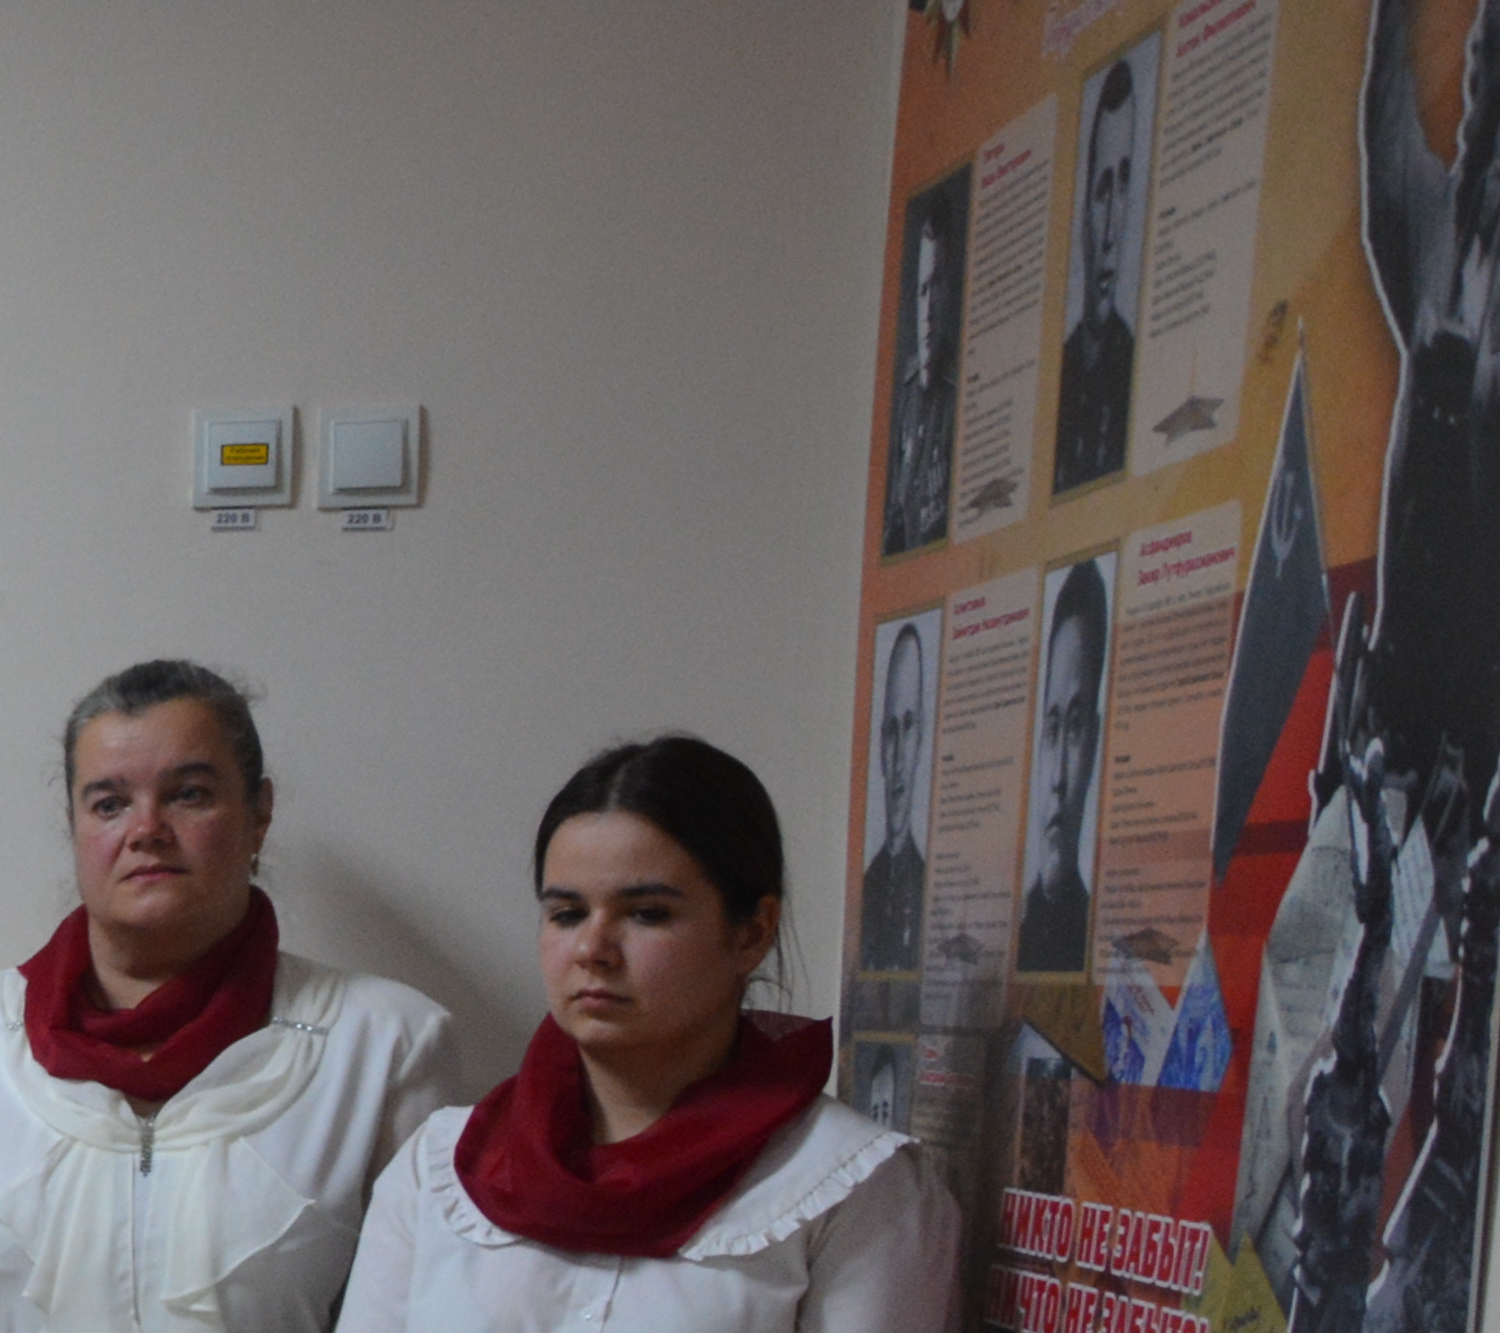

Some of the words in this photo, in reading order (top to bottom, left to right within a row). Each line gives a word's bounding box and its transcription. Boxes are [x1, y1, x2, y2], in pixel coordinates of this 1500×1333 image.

[998, 1188, 1075, 1263] НИКТО
[1075, 1201, 1113, 1271] НЕ
[1110, 1208, 1211, 1296] ЗАБЫТ!
